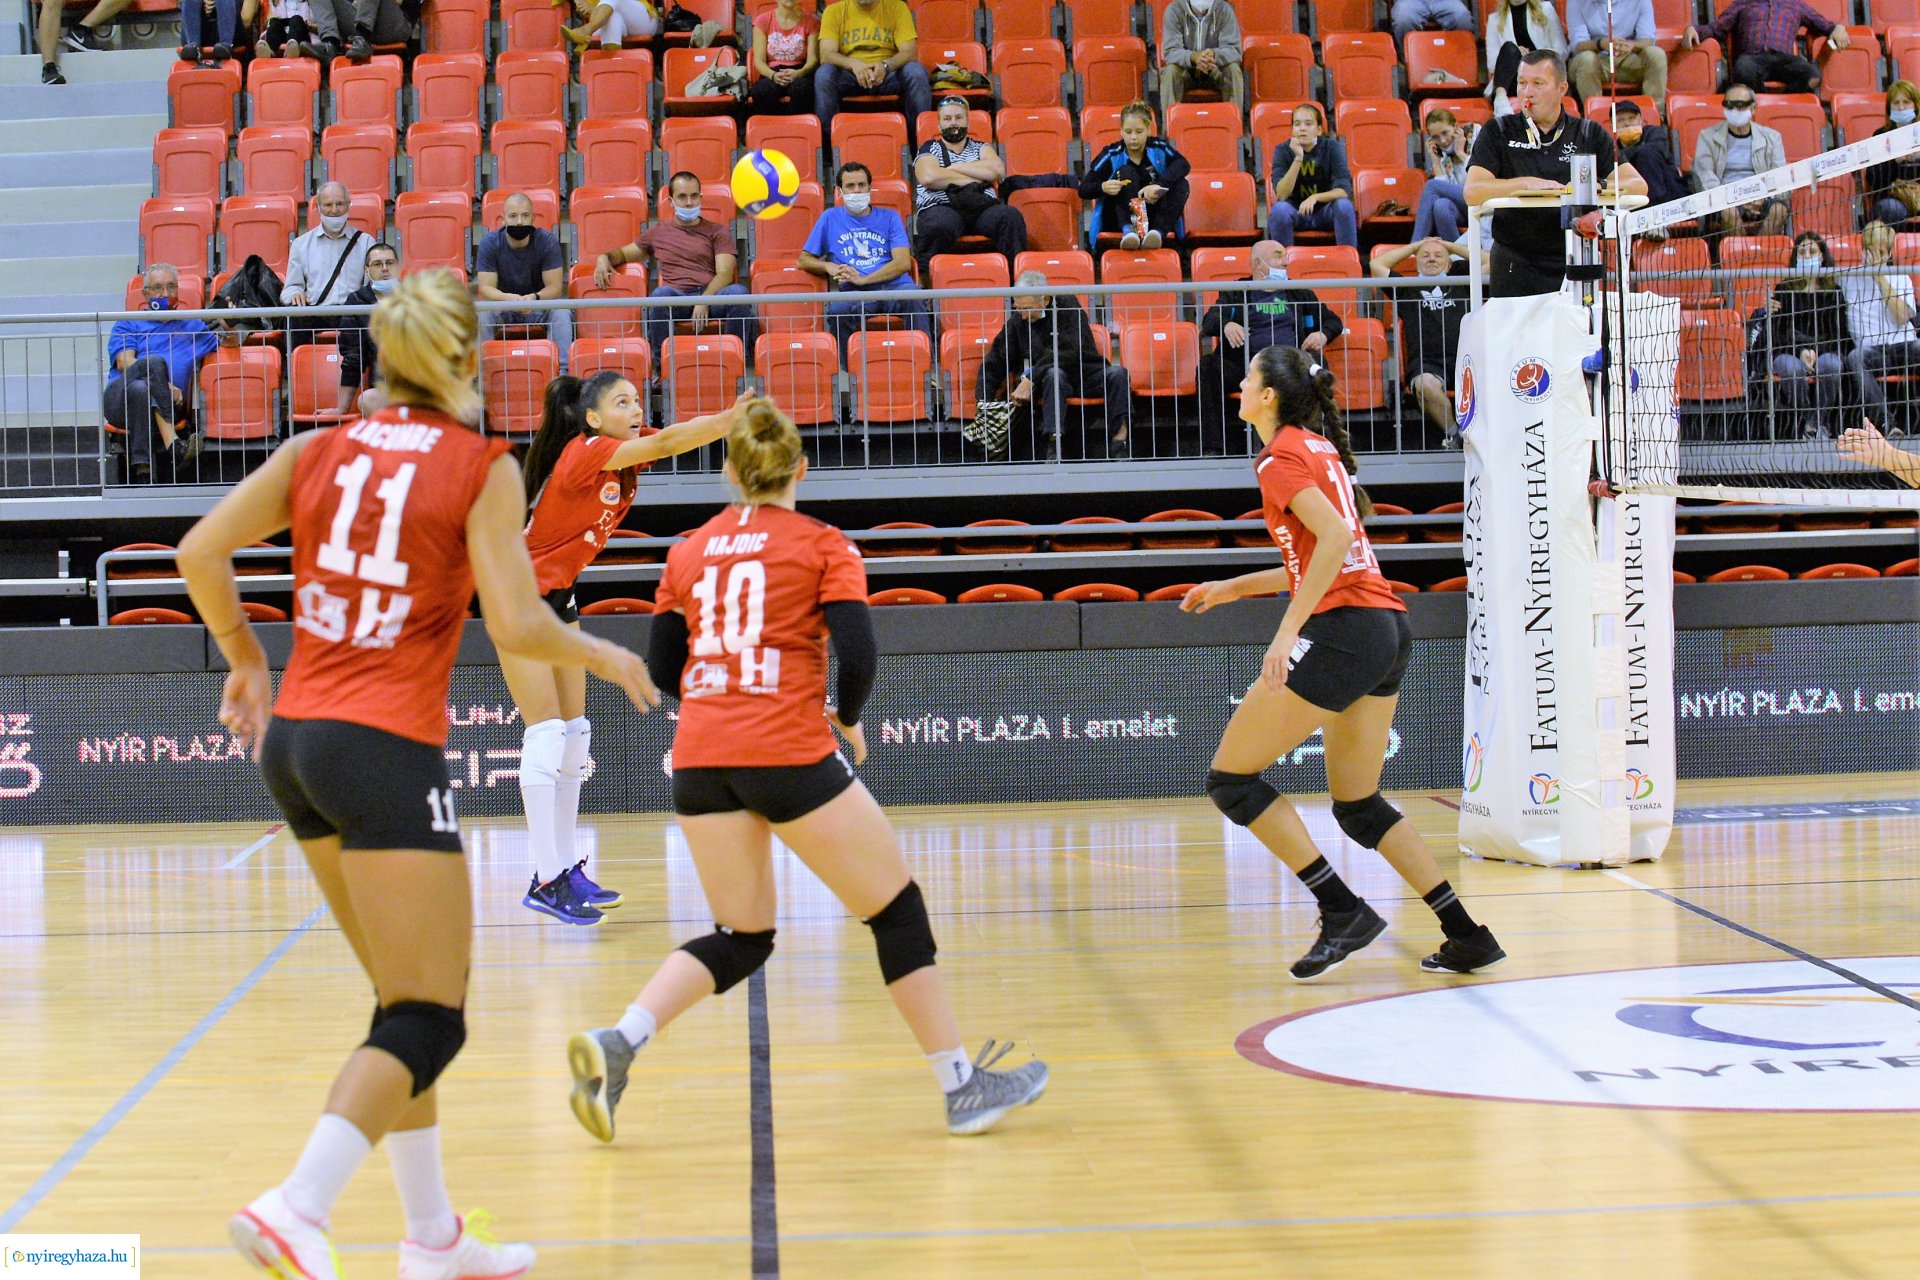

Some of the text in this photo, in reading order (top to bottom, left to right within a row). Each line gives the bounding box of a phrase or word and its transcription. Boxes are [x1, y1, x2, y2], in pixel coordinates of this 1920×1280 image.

[841, 26, 895, 46] RELAX
[837, 231, 887, 245] LEVI STRAUSS
[316, 453, 417, 588] 11
[703, 532, 768, 557] NAJDIC
[1521, 418, 1559, 755] FATUM-NYÍREGYHÁZA
[692, 560, 766, 658] 10
[1680, 687, 1747, 718] NYÍR
[1752, 687, 1843, 716] PLAZA
[881, 713, 950, 744] NYÍR
[957, 714, 1051, 742] PLAZA
[1084, 710, 1180, 740] emelet
[78, 733, 246, 763] NYÍR PLAZA
[427, 787, 459, 832] 11
[1522, 808, 1559, 816] NYÍREGYH
